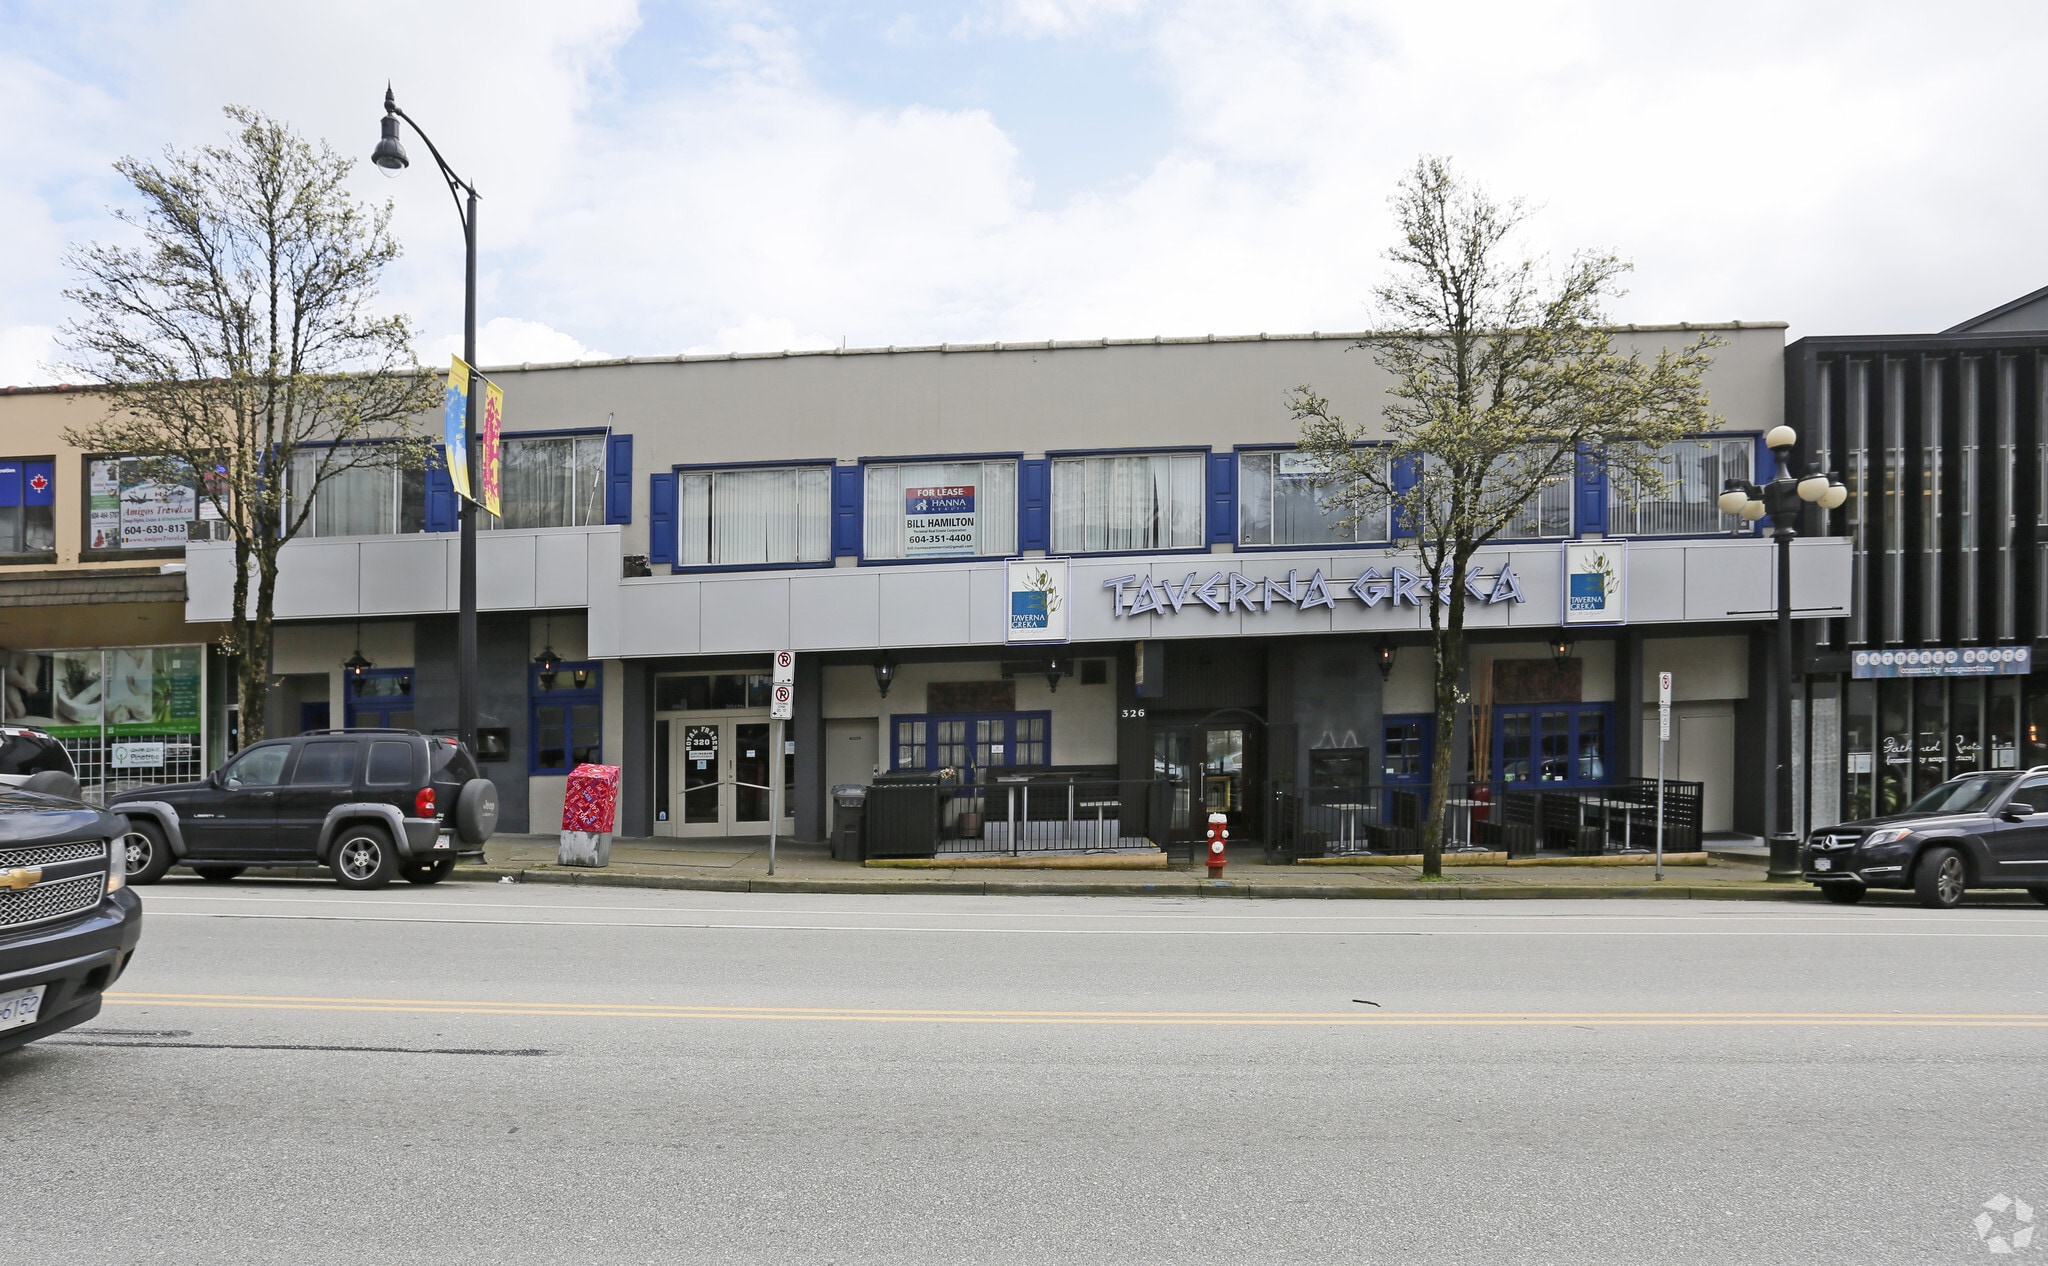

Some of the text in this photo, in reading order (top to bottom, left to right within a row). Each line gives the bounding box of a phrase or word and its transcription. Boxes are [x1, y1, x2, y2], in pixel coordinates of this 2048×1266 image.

[917, 488, 964, 497] FOR LEASE
[931, 498, 966, 507] HANNA
[124, 507, 154, 517] Amigos
[157, 505, 193, 515] Travel.ca
[907, 517, 974, 528] BILL HAMILTON
[909, 534, 972, 543] 604-351-4400
[1103, 568, 1337, 617] TAVERNA
[1857, 649, 2027, 665] GATHERED ROOTS
[1900, 665, 1994, 675] community acupuncture
[1121, 708, 1145, 718] 326
[686, 726, 718, 751] ROYAL FRASER
[1883, 735, 1983, 754] Gathred Roots
[483, 800, 495, 811] Jeep
